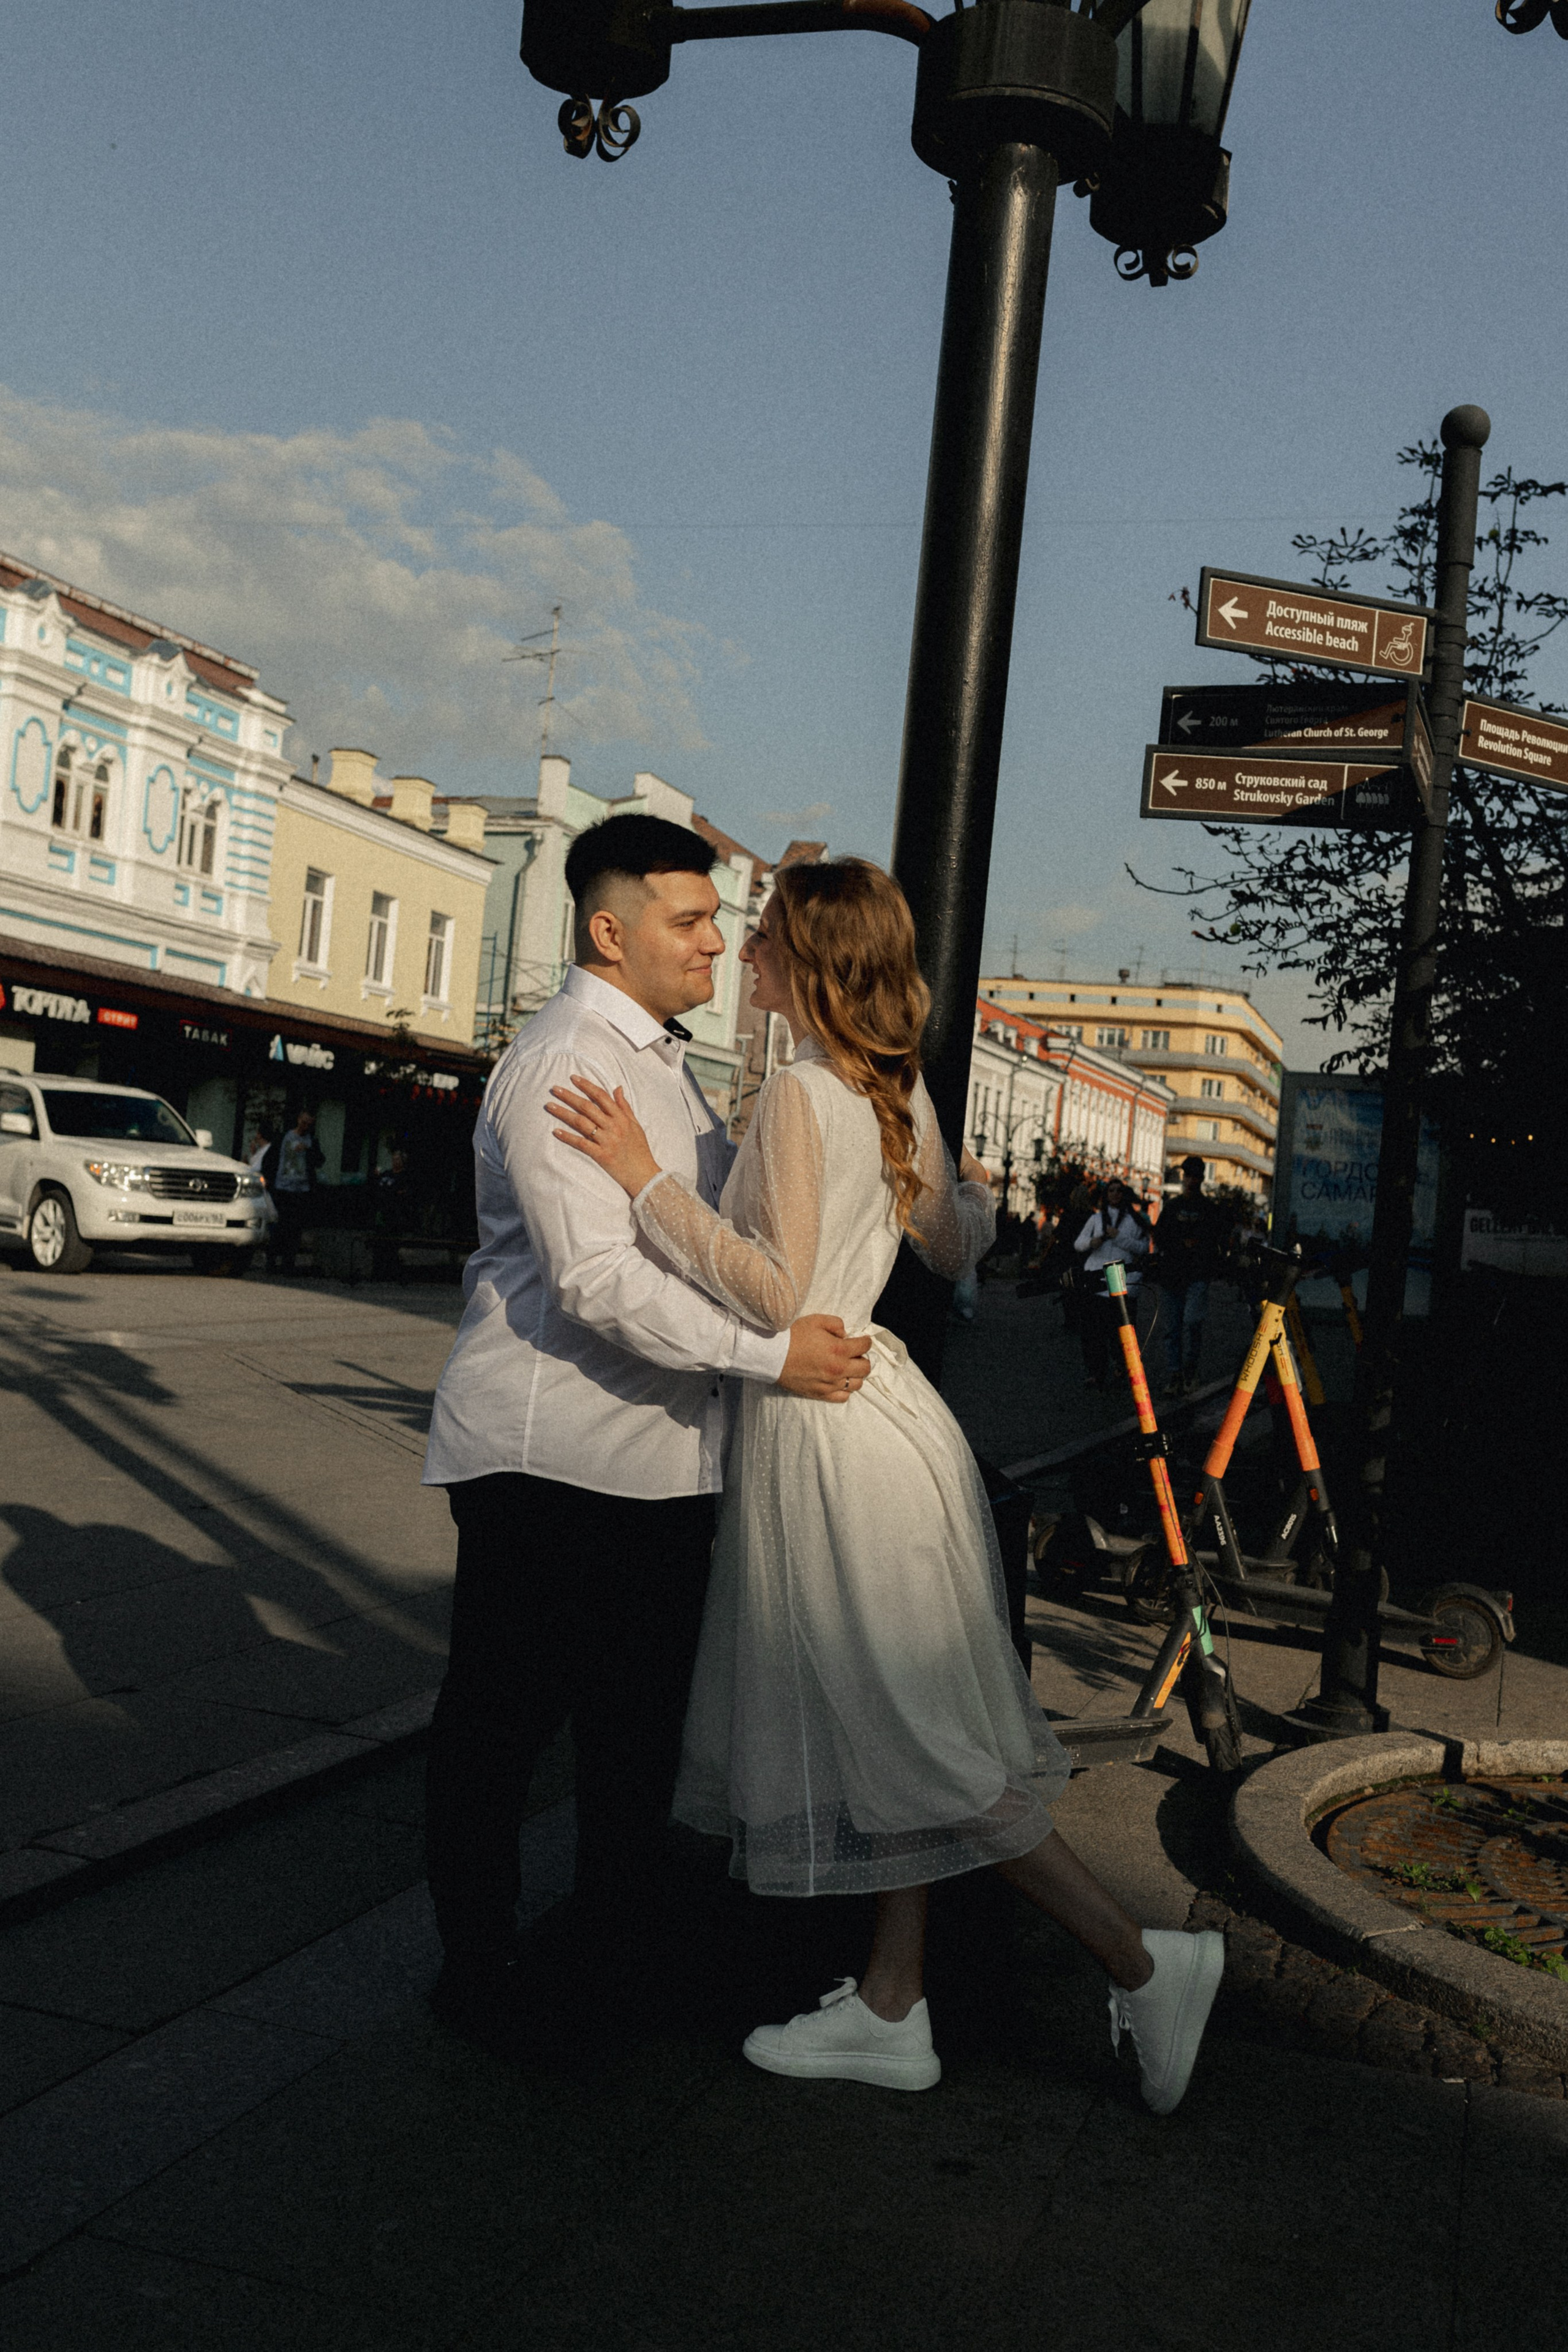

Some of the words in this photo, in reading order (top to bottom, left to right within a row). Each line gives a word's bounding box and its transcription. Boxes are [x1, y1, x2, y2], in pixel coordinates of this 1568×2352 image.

[1266, 600, 1334, 627] Доступный
[1336, 617, 1368, 633] пляж
[1265, 621, 1324, 645] Accessible
[1325, 631, 1359, 652] beach
[1209, 717, 1228, 726] 200
[1265, 715, 1298, 725] Святого
[1264, 728, 1302, 737] Lutheran
[1303, 727, 1332, 737] Church
[1333, 727, 1344, 737] of
[1344, 727, 1357, 737] St.
[1357, 728, 1389, 739] George
[1480, 718, 1520, 741] Площадь
[1521, 730, 1568, 754] Революции
[1478, 735, 1523, 758] Revolution
[1523, 748, 1552, 766] Square
[1195, 778, 1215, 790] 850
[1216, 781, 1227, 790] м
[1235, 772, 1305, 788] Струковский
[1307, 779, 1328, 791] сад
[1234, 789, 1293, 806] Strukovsky
[1295, 793, 1335, 806] Garden
[184, 1025, 228, 1047] ТАБАК
[1241, 1333, 1264, 1382] WHOOSH
[1214, 1515, 1227, 1546] AA2396
